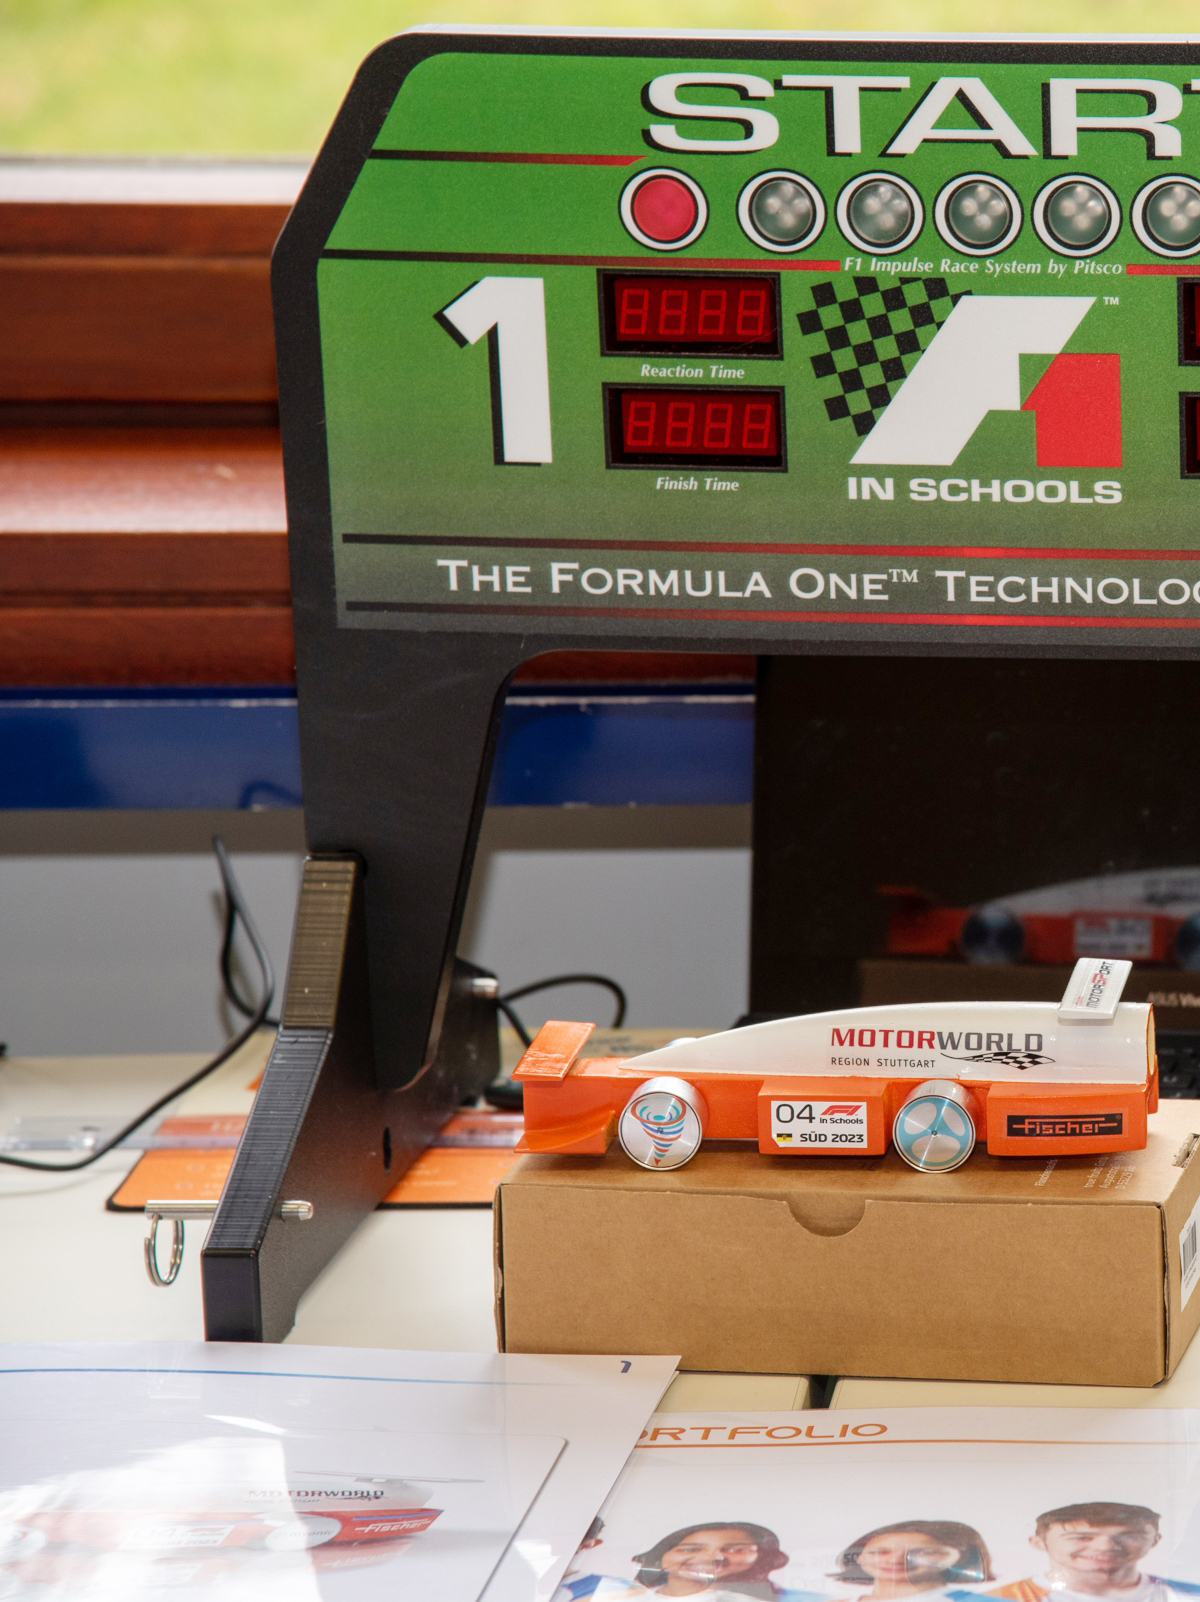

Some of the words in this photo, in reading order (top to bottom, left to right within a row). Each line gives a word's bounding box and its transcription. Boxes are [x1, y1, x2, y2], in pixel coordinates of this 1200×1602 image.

[844, 257, 862, 271] F1
[870, 258, 934, 275] Impulse
[940, 259, 979, 273] Race
[985, 260, 1041, 277] System
[1048, 262, 1068, 277] by
[1073, 262, 1123, 275] Pitsco
[433, 276, 553, 466] 1
[640, 364, 704, 379] Reaction
[708, 365, 745, 380] Time
[656, 477, 698, 492] Finish
[703, 478, 739, 493] Time
[847, 477, 895, 500] IN
[908, 477, 1123, 505] SCHOOLS
[437, 559, 532, 592] THE
[550, 561, 772, 599] FORMULA
[1086, 961, 1114, 1008] MOTORSPORT
[831, 1028, 1043, 1052] MOTORWORLD
[831, 1057, 870, 1067] REGION
[877, 1058, 935, 1068] STUTTGART
[776, 1104, 815, 1123] 04
[829, 1117, 864, 1125] Schools
[800, 1131, 827, 1142] SÜD
[831, 1134, 864, 1143] 2023
[249, 1490, 384, 1499] MOTORWORLD
